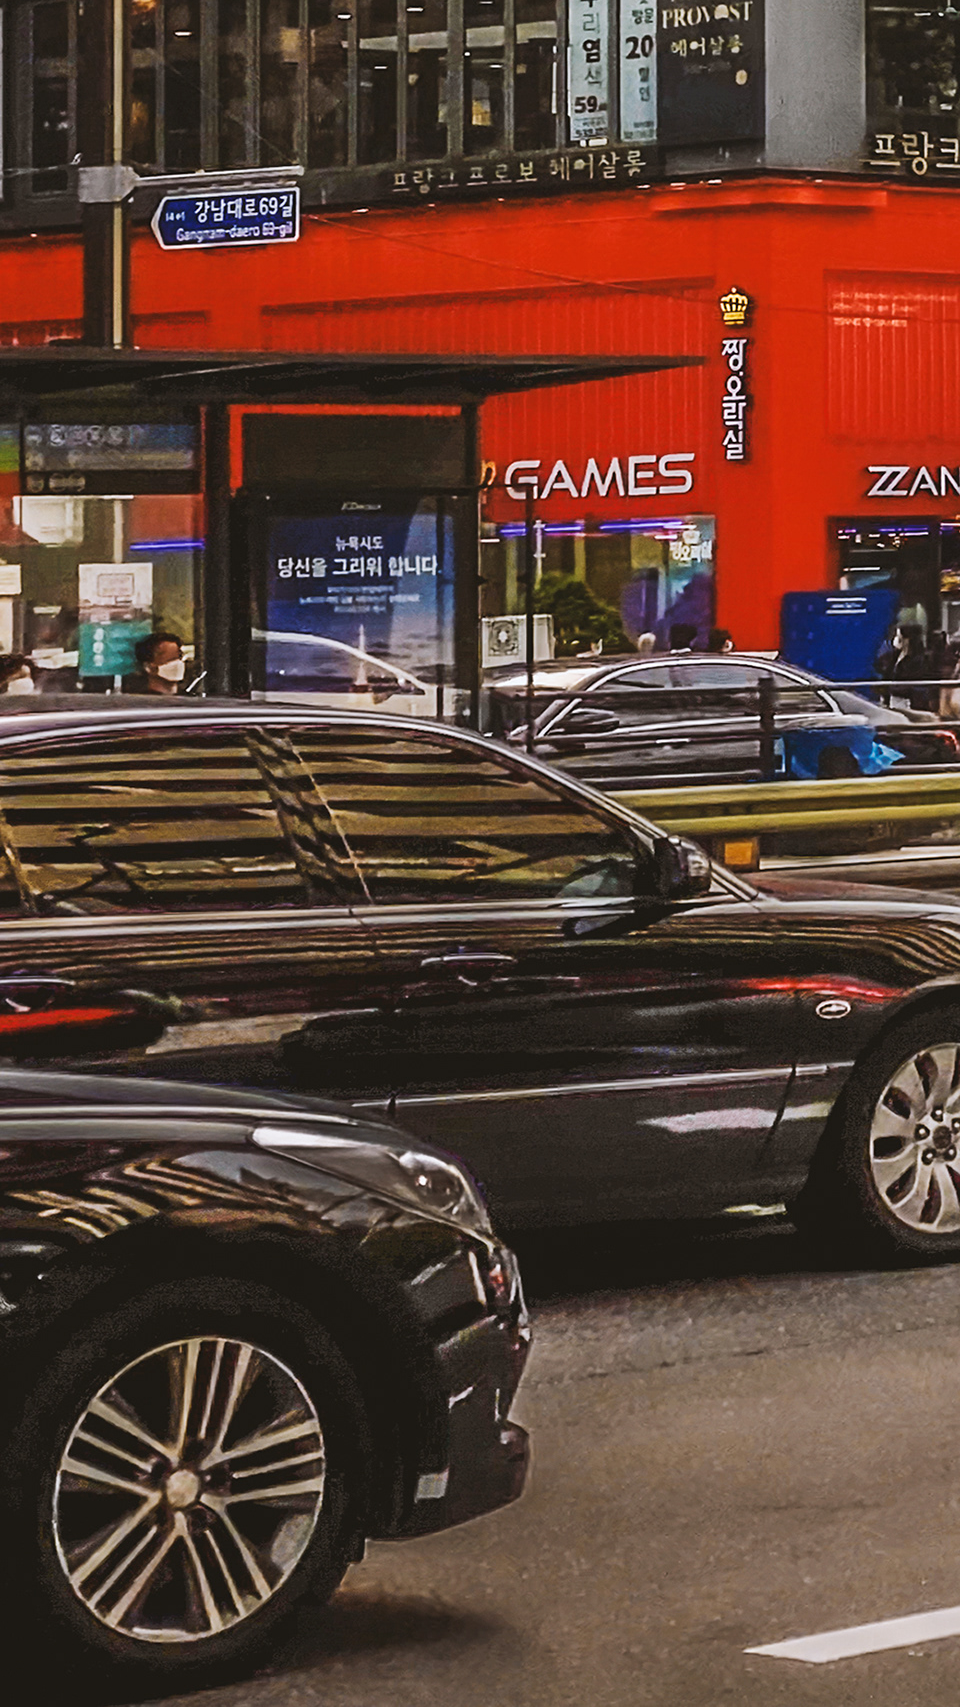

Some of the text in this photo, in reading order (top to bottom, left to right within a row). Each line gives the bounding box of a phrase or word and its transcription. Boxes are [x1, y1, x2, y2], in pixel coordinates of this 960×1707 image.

[662, 1, 753, 29] PROVOST
[504, 453, 695, 500] GAMES
[277, 556, 327, 578] 당신을
[332, 556, 382, 578] 그리워
